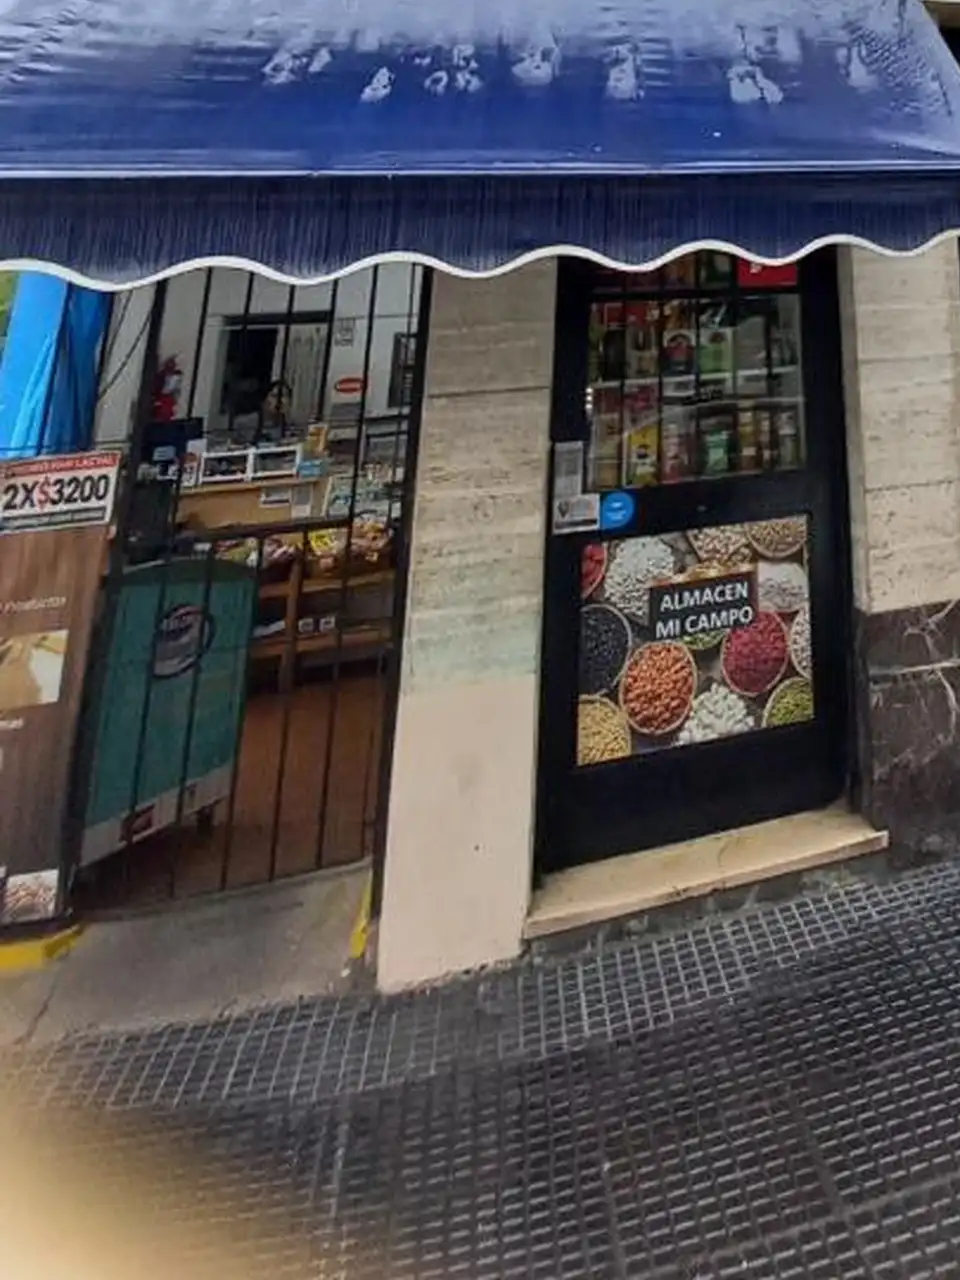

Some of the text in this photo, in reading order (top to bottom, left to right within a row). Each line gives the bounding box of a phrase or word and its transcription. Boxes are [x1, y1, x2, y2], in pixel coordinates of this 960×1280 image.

[660, 581, 748, 612] ALMACEN
[656, 606, 753, 639] MI CAMPO
